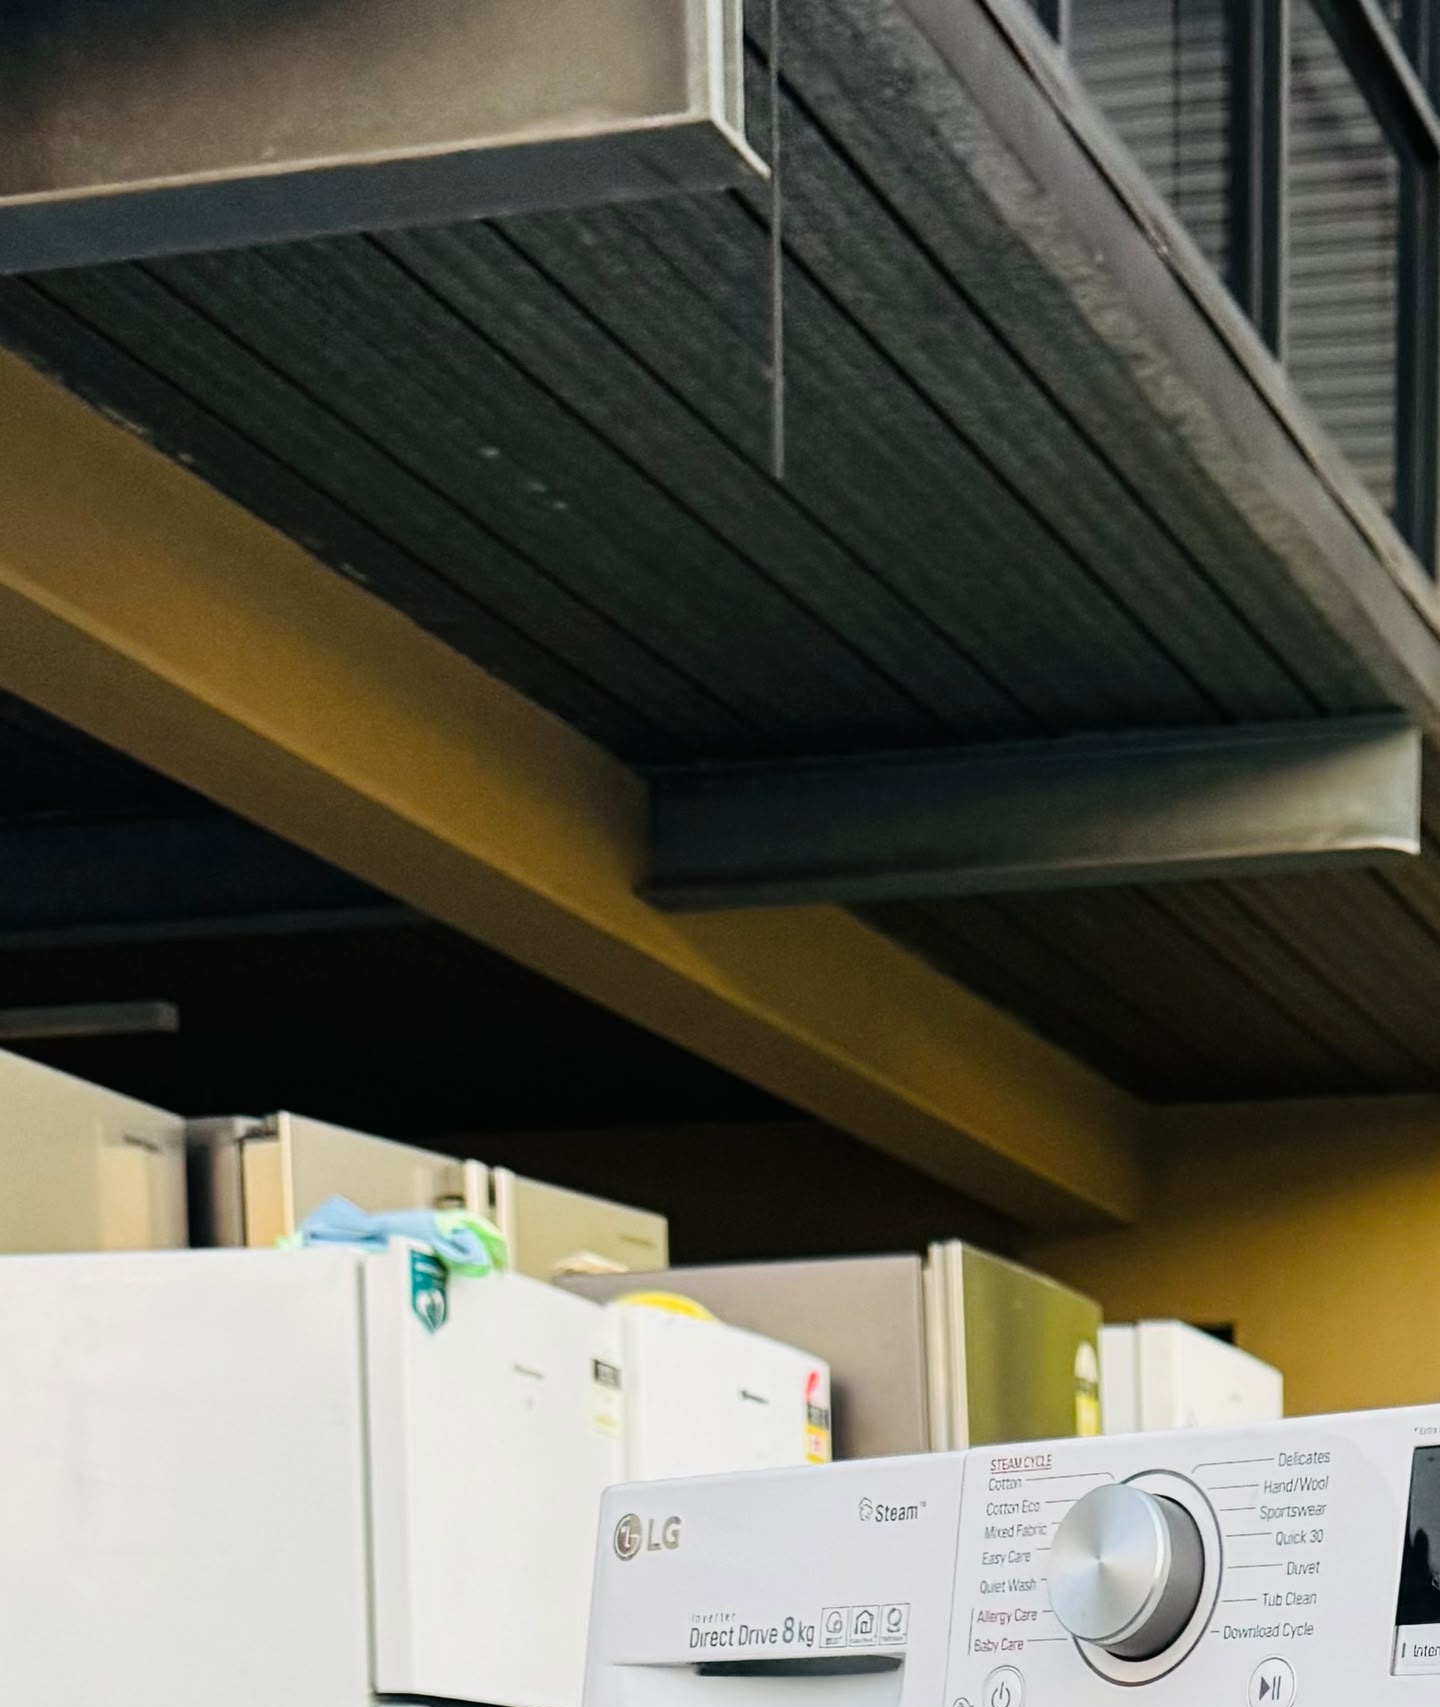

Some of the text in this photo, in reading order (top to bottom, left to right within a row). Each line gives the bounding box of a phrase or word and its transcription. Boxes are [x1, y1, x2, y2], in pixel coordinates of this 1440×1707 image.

[991, 1455, 1052, 1471] STEAM CYCLE
[1278, 1452, 1331, 1467] Delicates
[988, 1478, 1022, 1491] Cotton
[1264, 1476, 1329, 1494] Hand/Wool
[986, 1500, 1040, 1516] Cotton Eco
[1260, 1504, 1327, 1522] Sportswear
[647, 1515, 682, 1551] LG
[1275, 1529, 1324, 1546] Quick 30
[982, 1550, 1031, 1566] Easy Care
[1287, 1561, 1320, 1575] Duvet
[1263, 1592, 1317, 1606] Tub Clean
[1015, 1608, 1038, 1621] Care
[690, 1616, 815, 1648] Direct Drive 8 kg
[1223, 1622, 1314, 1639] Download Cycle
[1001, 1638, 1024, 1651] Care
